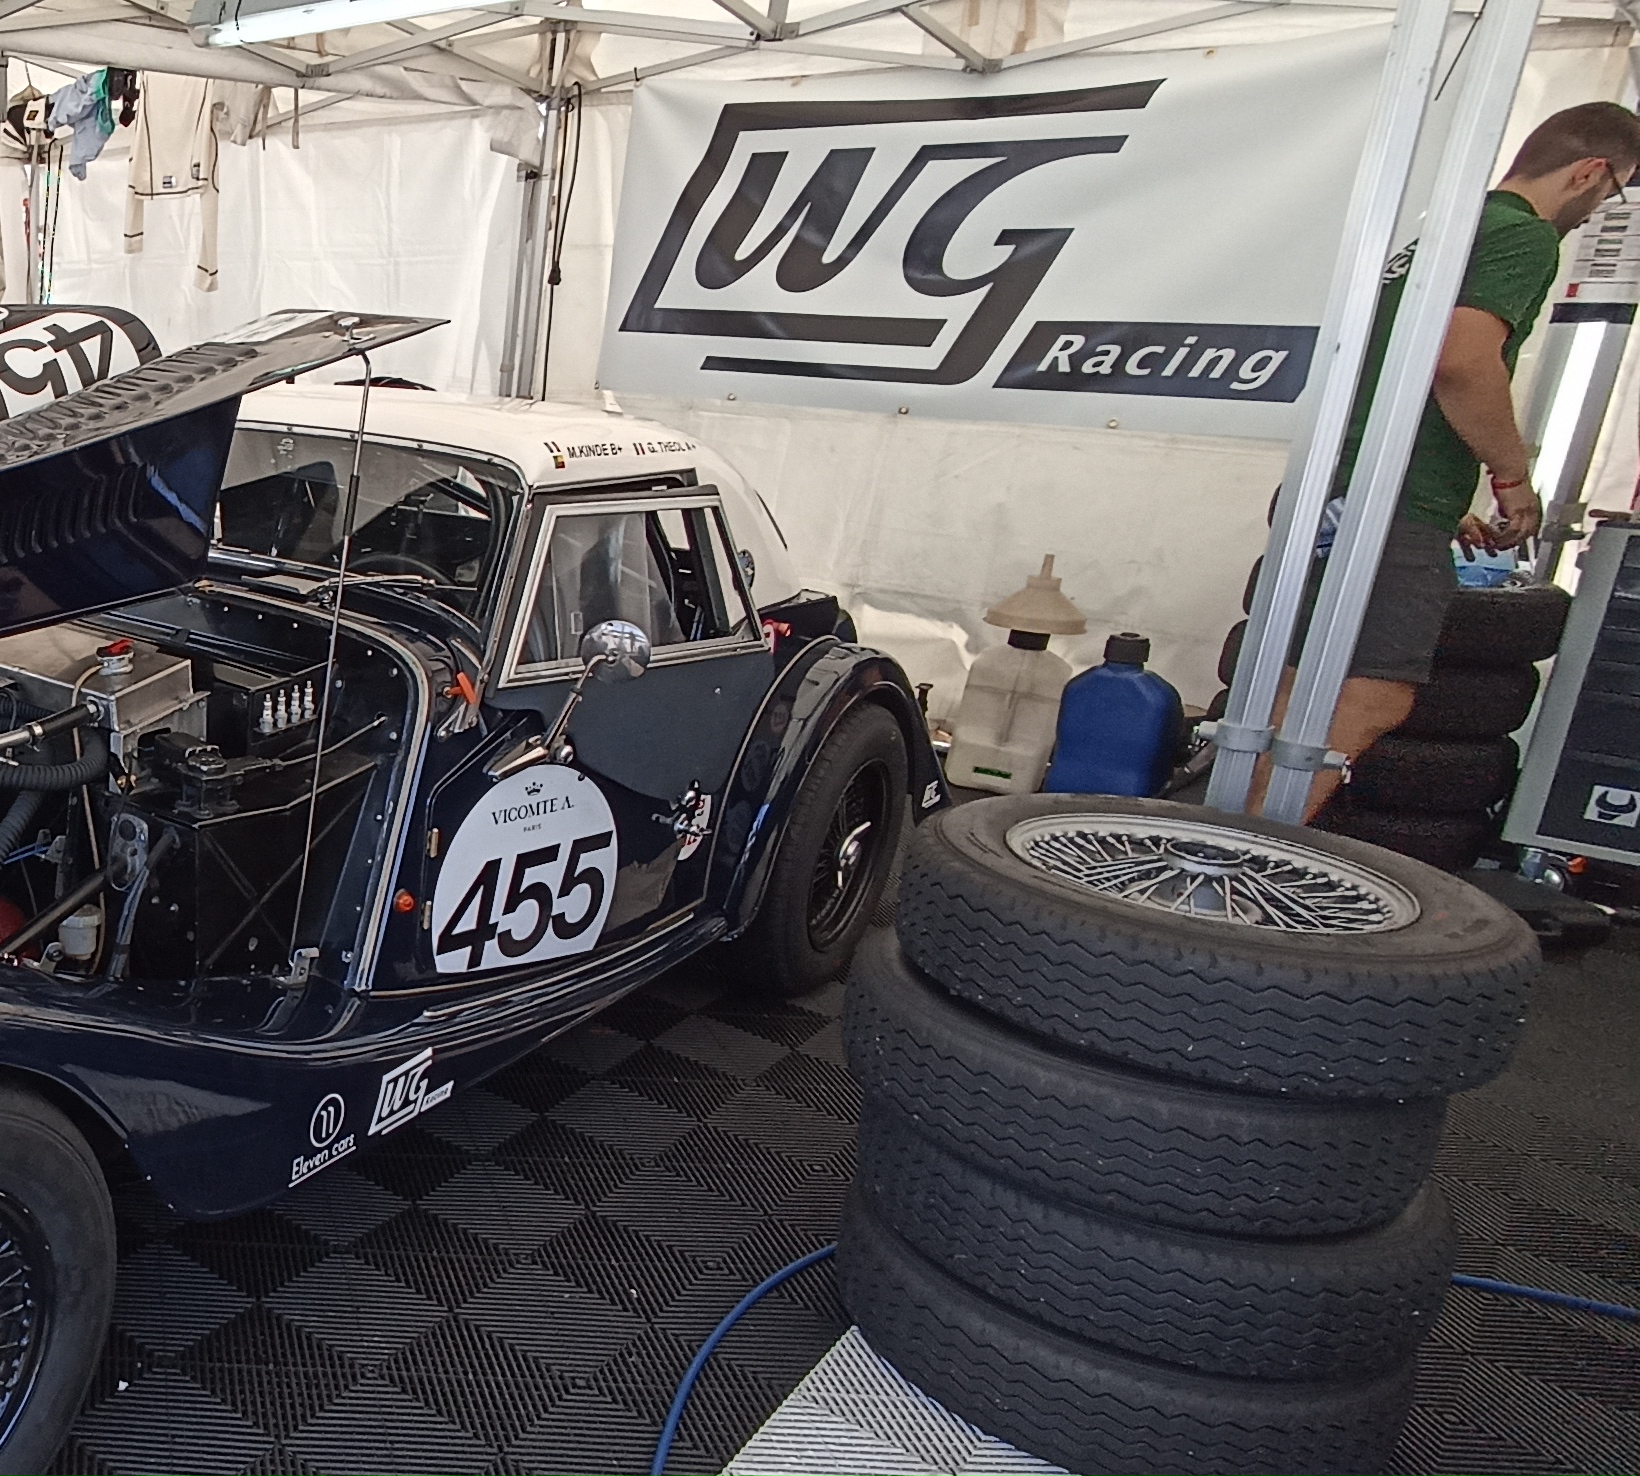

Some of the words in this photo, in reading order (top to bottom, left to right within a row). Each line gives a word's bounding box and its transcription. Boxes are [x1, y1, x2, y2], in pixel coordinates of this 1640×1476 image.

[695, 135, 1129, 385] WG
[1035, 334, 1290, 391] Racing
[491, 797, 558, 825] VICOMTE
[436, 830, 614, 971] 455
[378, 1058, 433, 1134] WG
[291, 1149, 329, 1181] Eleven
[331, 1133, 355, 1156] cars
